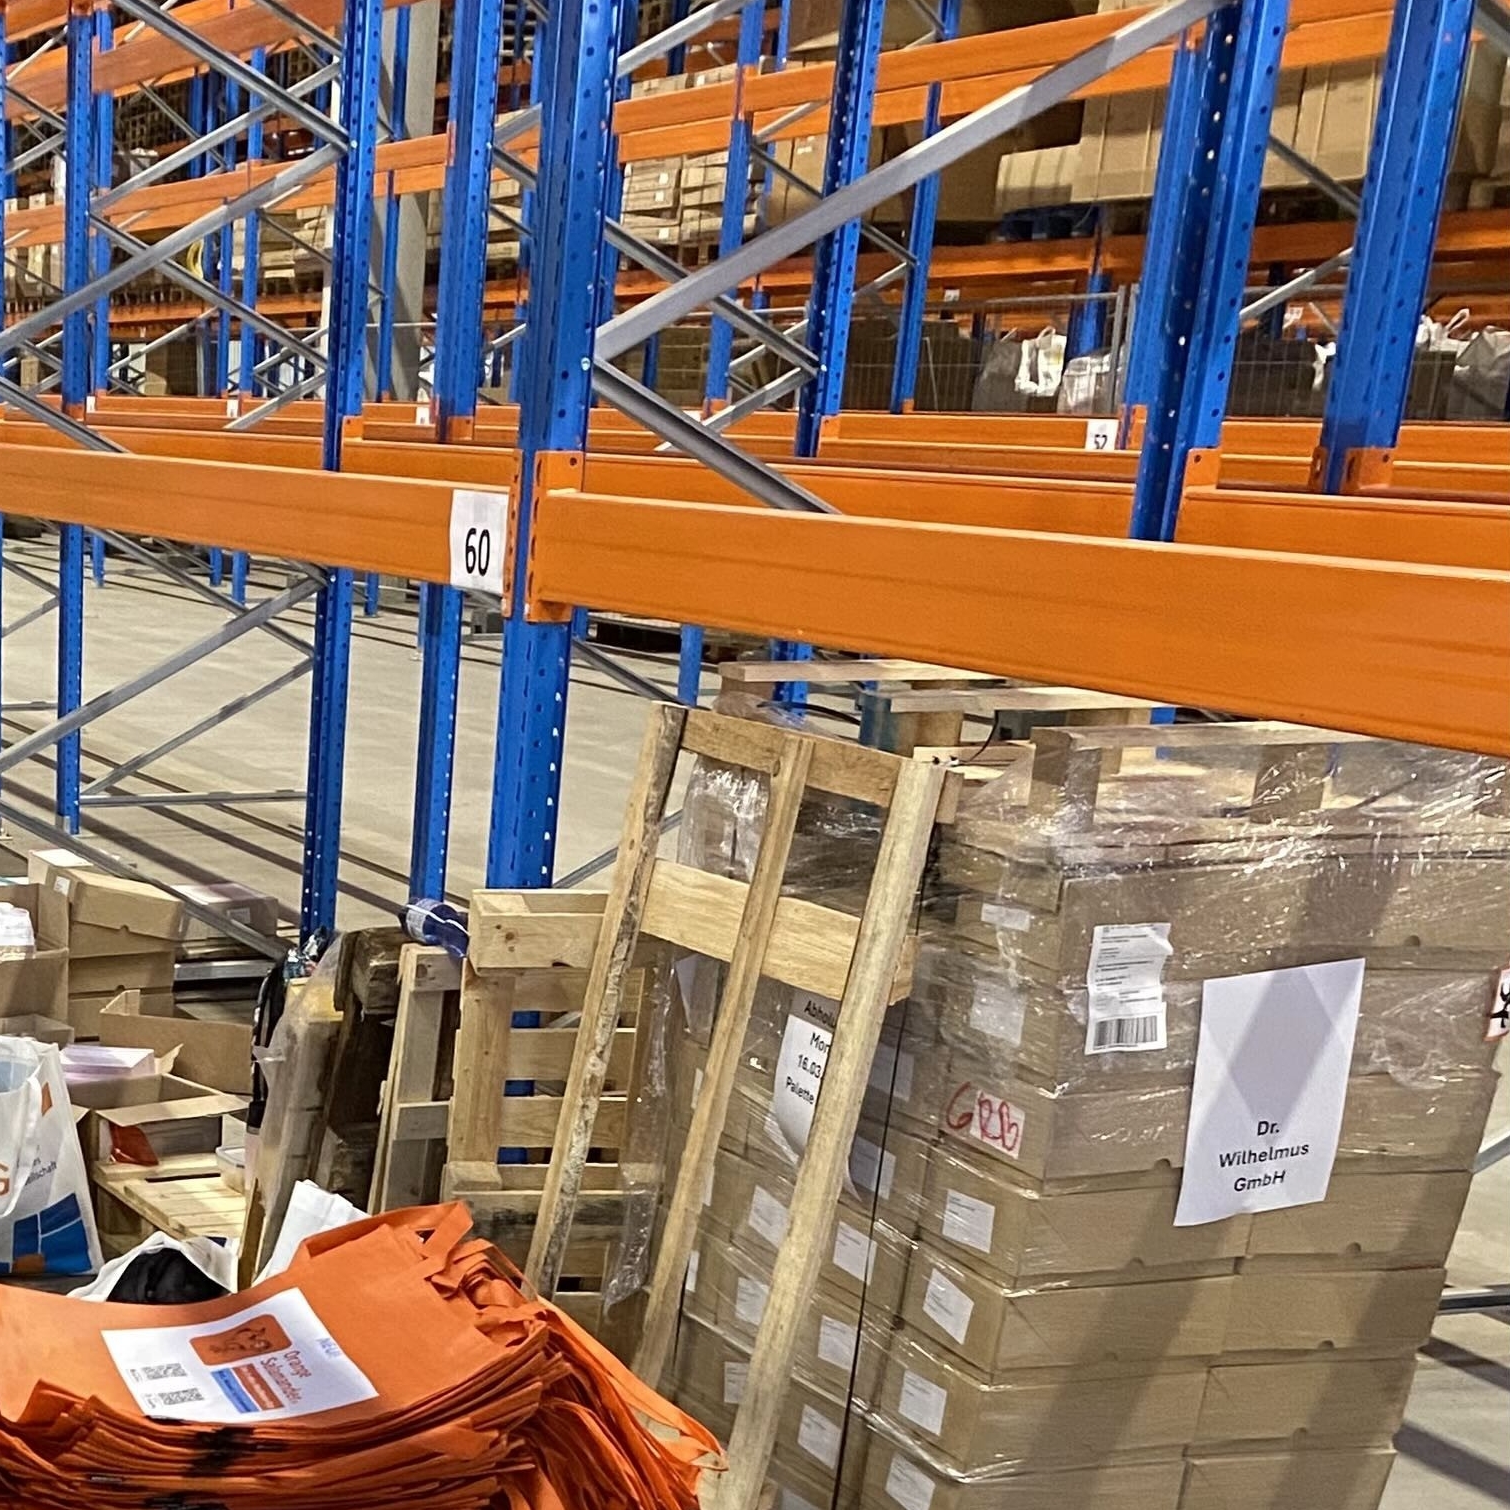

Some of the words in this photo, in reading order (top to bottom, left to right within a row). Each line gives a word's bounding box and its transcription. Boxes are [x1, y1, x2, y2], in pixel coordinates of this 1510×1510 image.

[465, 527, 491, 577] 60
[804, 1000, 836, 1028] Abholu
[810, 1032, 831, 1054] Mon
[786, 1076, 815, 1105] Palette
[1257, 1120, 1280, 1136] Dr.
[1219, 1144, 1309, 1168] Wilhelmus
[1234, 1169, 1286, 1192] GmbH
[283, 1350, 312, 1378] Orange
